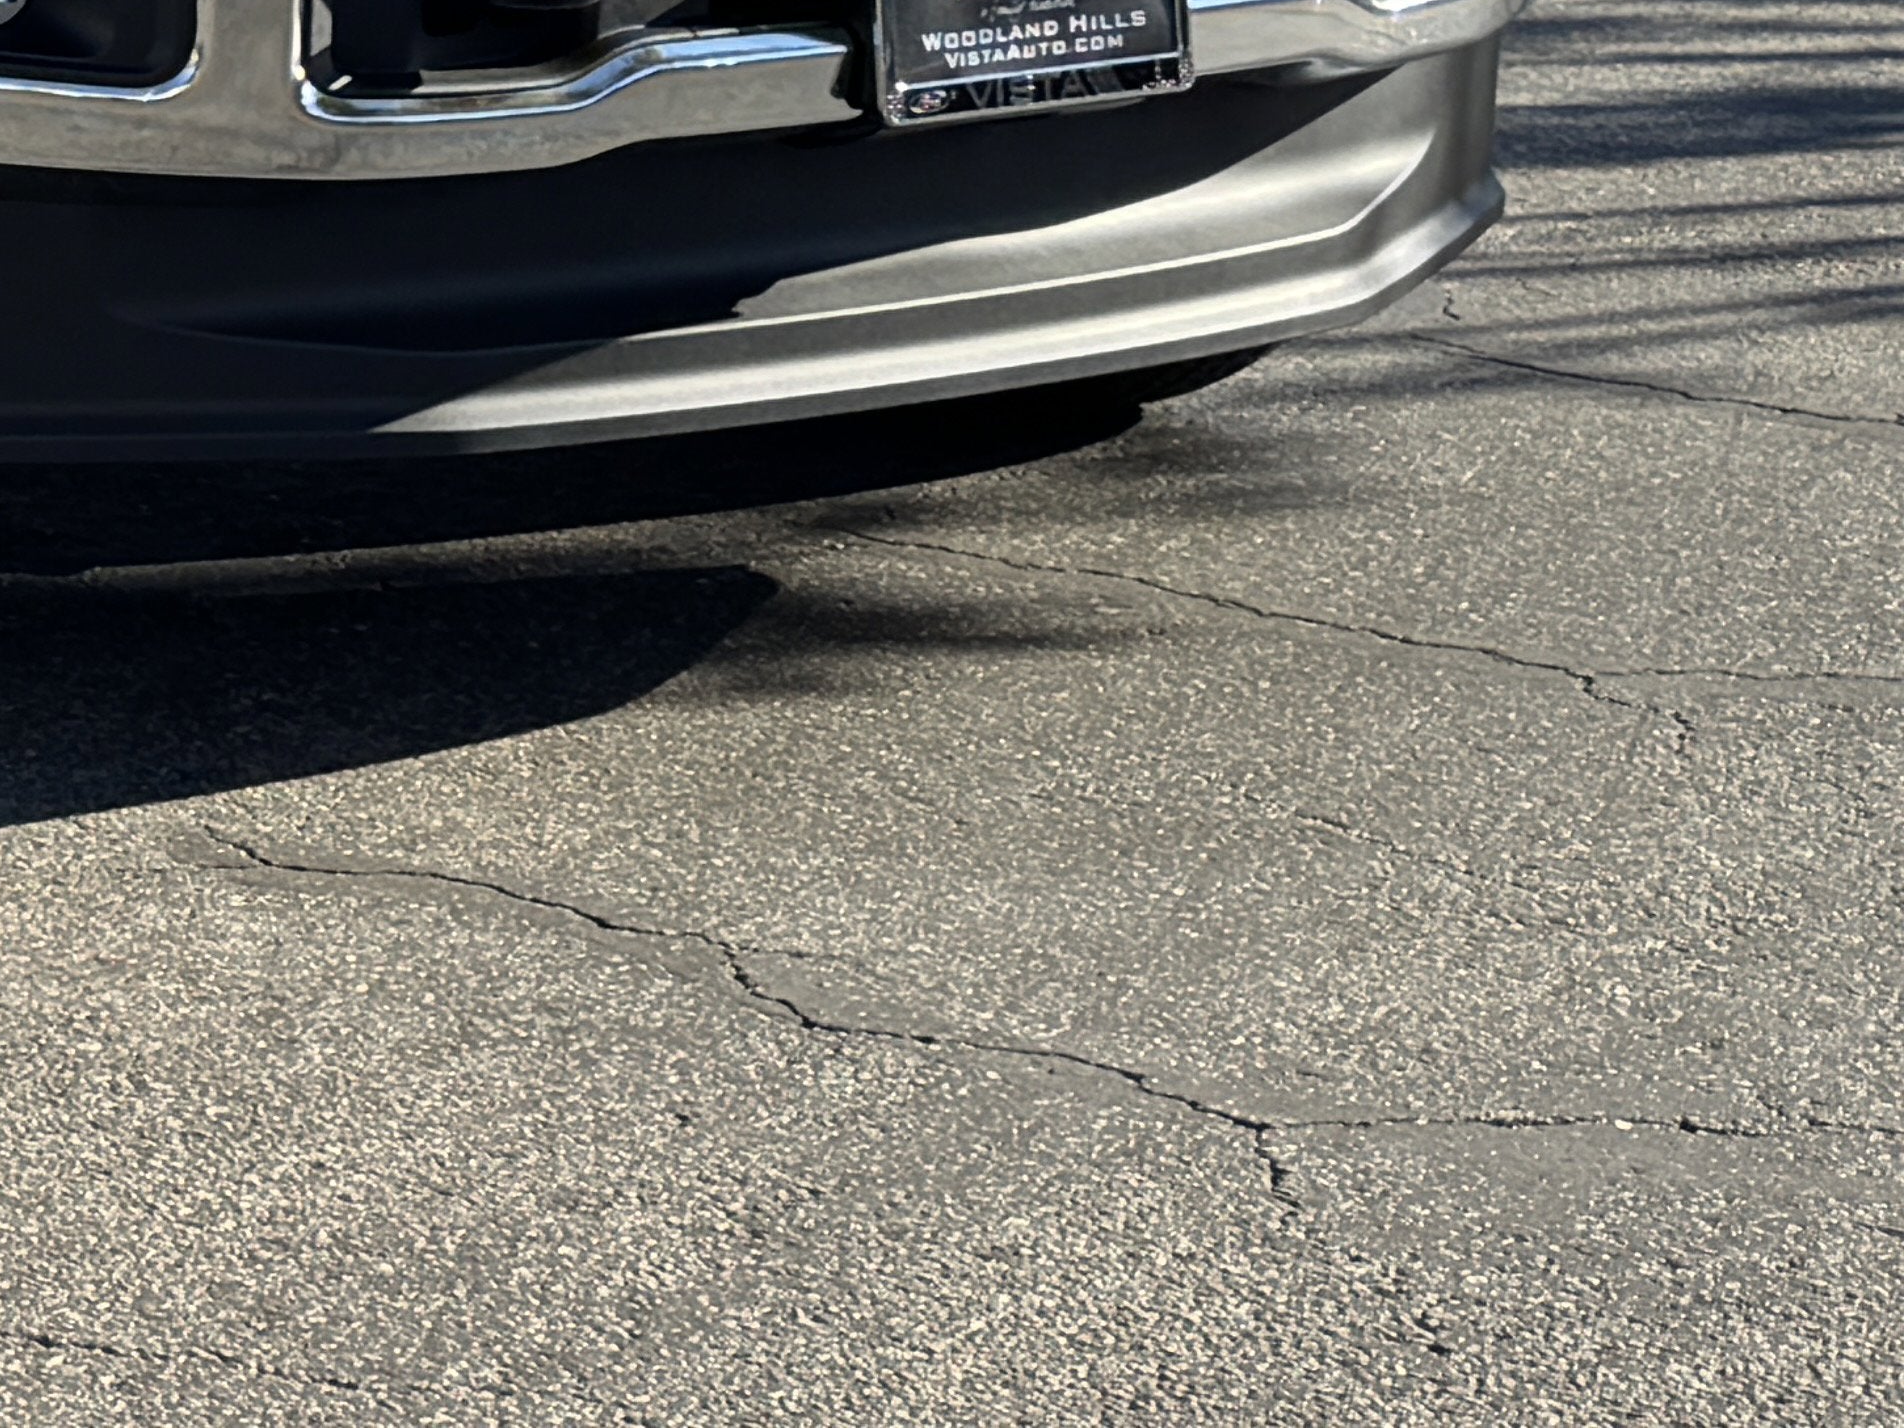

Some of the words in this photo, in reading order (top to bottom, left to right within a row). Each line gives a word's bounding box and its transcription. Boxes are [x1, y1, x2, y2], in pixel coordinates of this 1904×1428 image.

[921, 20, 1059, 52] WOODLAND
[1068, 9, 1147, 34] HILLS
[944, 34, 1124, 70] VISTAAUTO.COM
